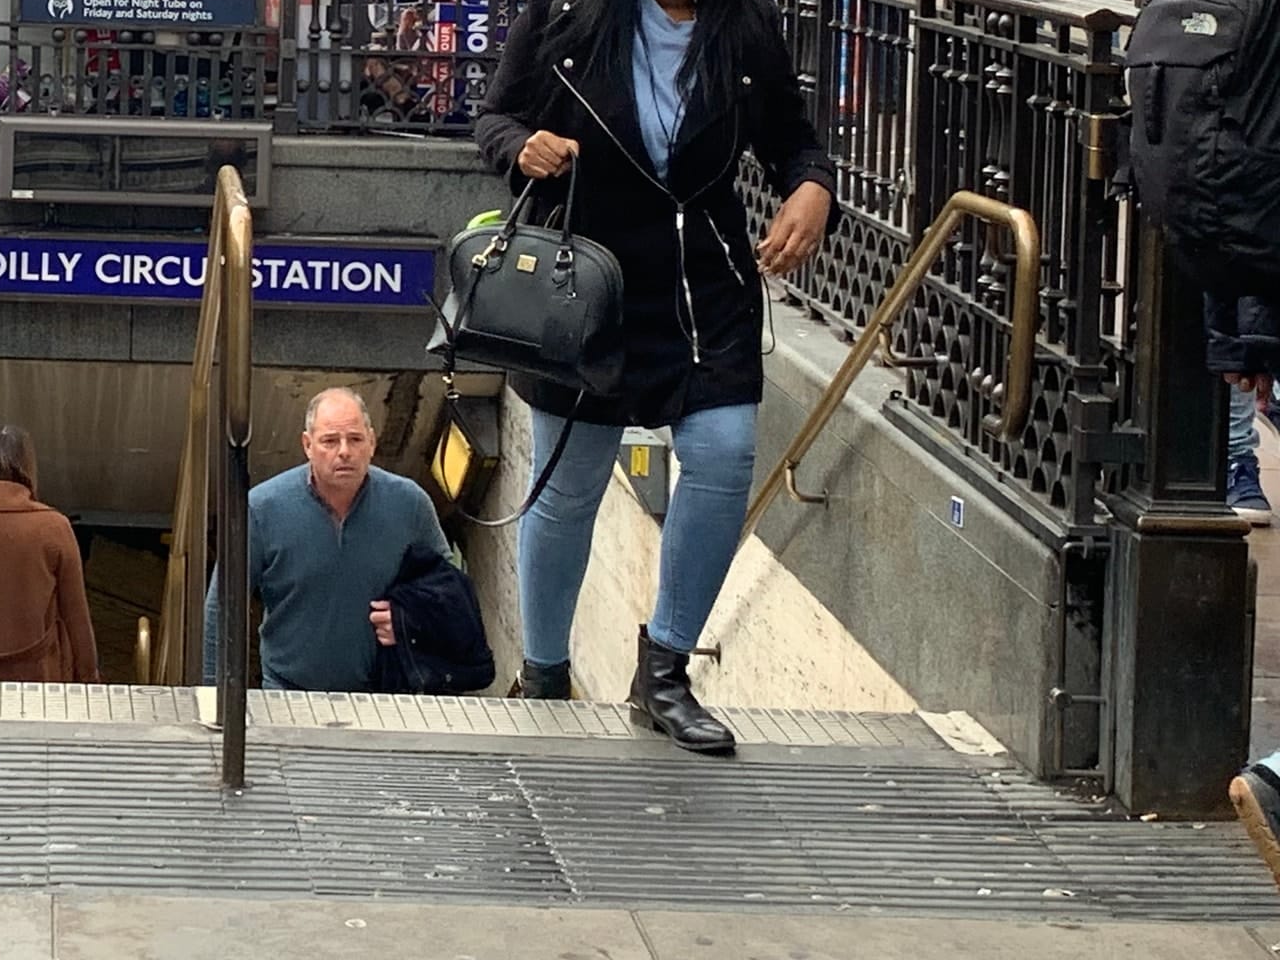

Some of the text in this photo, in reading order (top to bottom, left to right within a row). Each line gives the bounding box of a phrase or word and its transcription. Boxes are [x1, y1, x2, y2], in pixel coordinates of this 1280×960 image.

[83, 8, 213, 22] Friday and Saturday nights
[189, 0, 203, 9] on
[440, 25, 451, 51] OUR
[467, 13, 488, 53] ON
[95, 253, 226, 287] CIRCU
[250, 257, 403, 292] STATION
